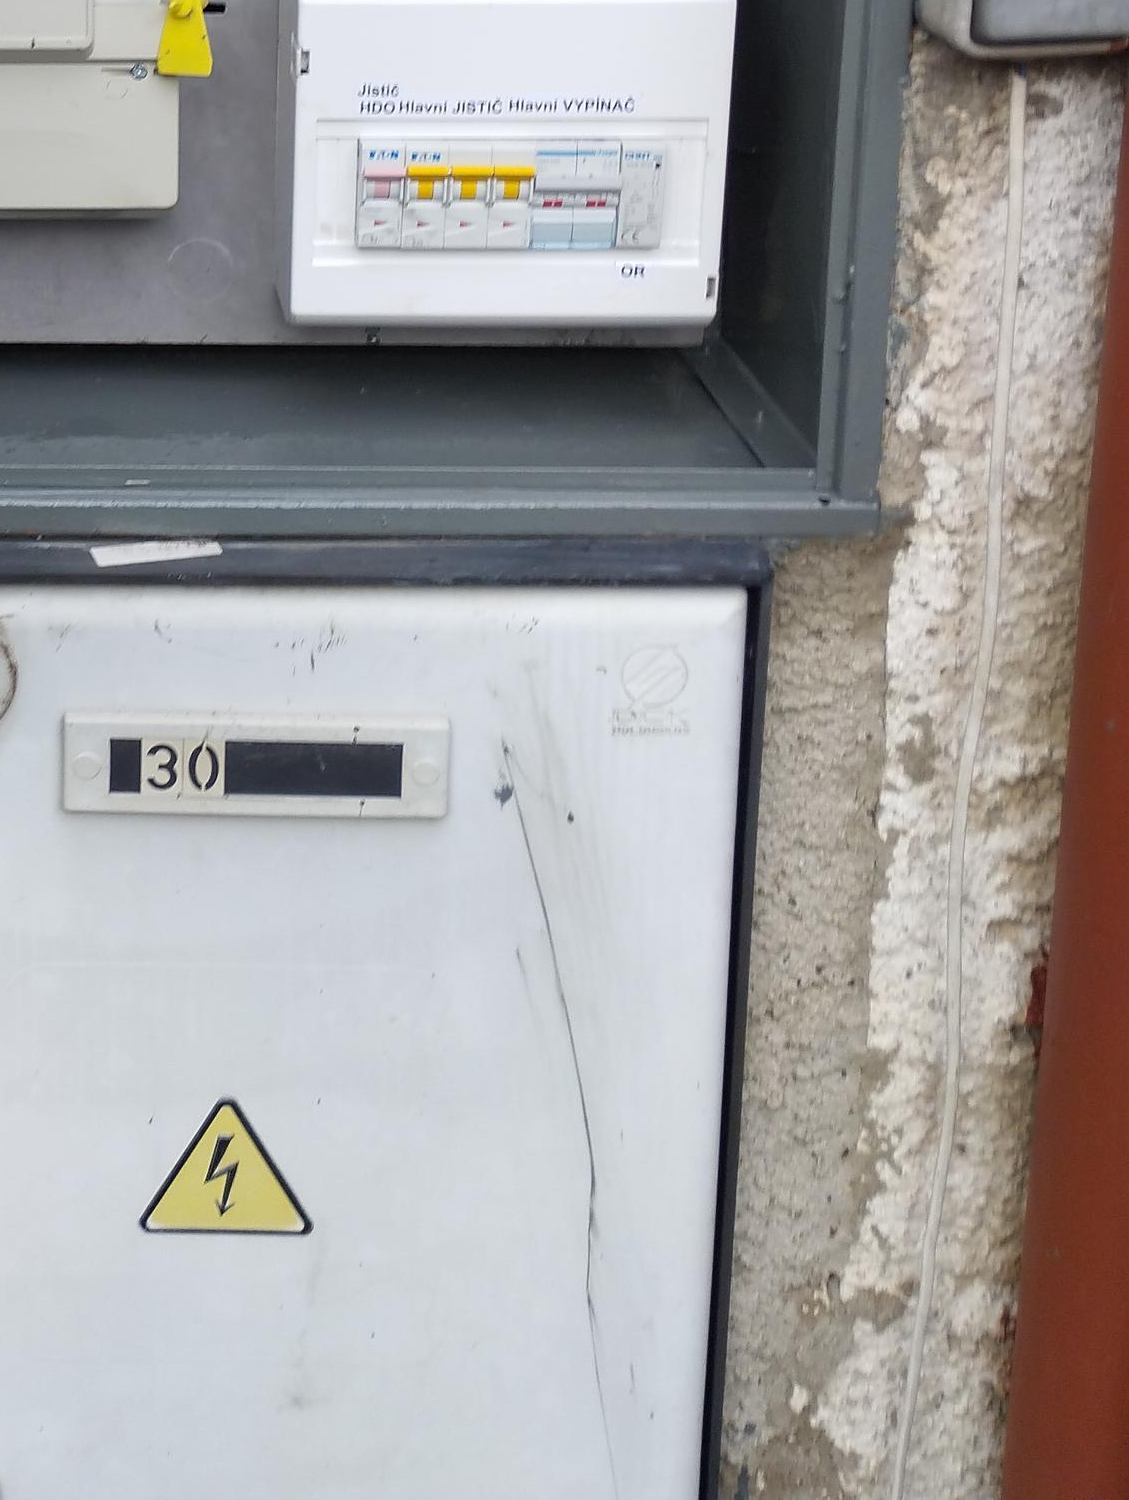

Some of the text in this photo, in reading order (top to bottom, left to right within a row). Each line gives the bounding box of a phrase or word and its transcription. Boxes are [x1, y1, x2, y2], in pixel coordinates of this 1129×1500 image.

[357, 83, 399, 98] Jistič
[359, 100, 396, 115] HDO
[398, 100, 447, 115] Hlavní
[451, 98, 502, 115] JISTIČ
[508, 100, 558, 114] Hlavní
[145, 743, 219, 792] 30
